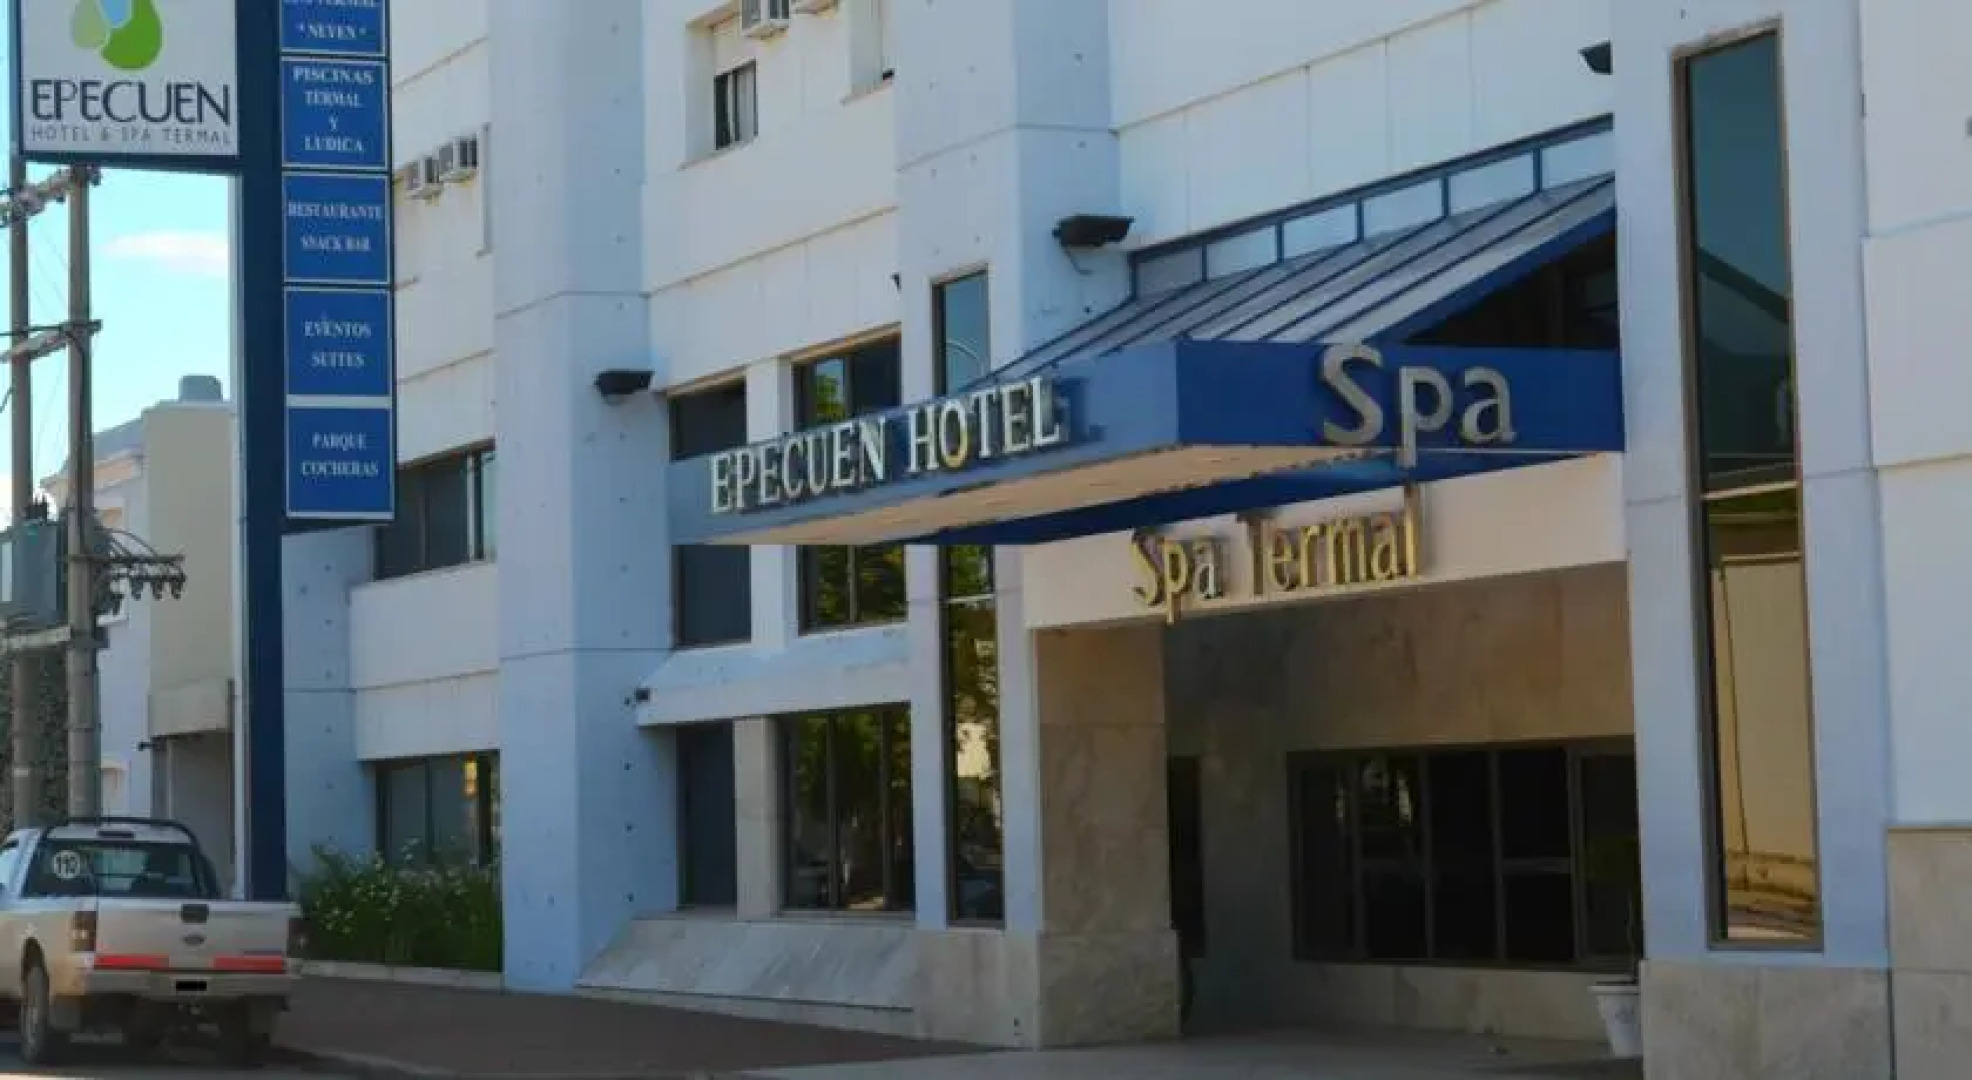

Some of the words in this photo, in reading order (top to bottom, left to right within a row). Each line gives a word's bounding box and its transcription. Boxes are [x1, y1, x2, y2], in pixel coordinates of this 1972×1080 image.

[292, 66, 375, 85] PISCINAS
[31, 80, 231, 126] EPECUEN
[304, 90, 363, 107] TERMAL
[328, 115, 339, 131] Y
[32, 126, 90, 142] HOTEL
[101, 127, 111, 142] &
[121, 127, 151, 142] SPA
[162, 128, 231, 144] TERMAL
[287, 202, 385, 219] RESTAURANTE
[301, 235, 341, 251] SNACK
[346, 236, 371, 252] BAR
[304, 320, 372, 338] EVENTOS
[311, 351, 365, 368] SUITES
[1319, 342, 1518, 468] Spa
[312, 432, 367, 451] PARQUE
[709, 415, 888, 514] EPECUEN
[907, 375, 1067, 473] HOTEL
[302, 460, 379, 477] COCHERAS
[1131, 526, 1225, 624] Spa
[1236, 481, 1422, 597] Termal
